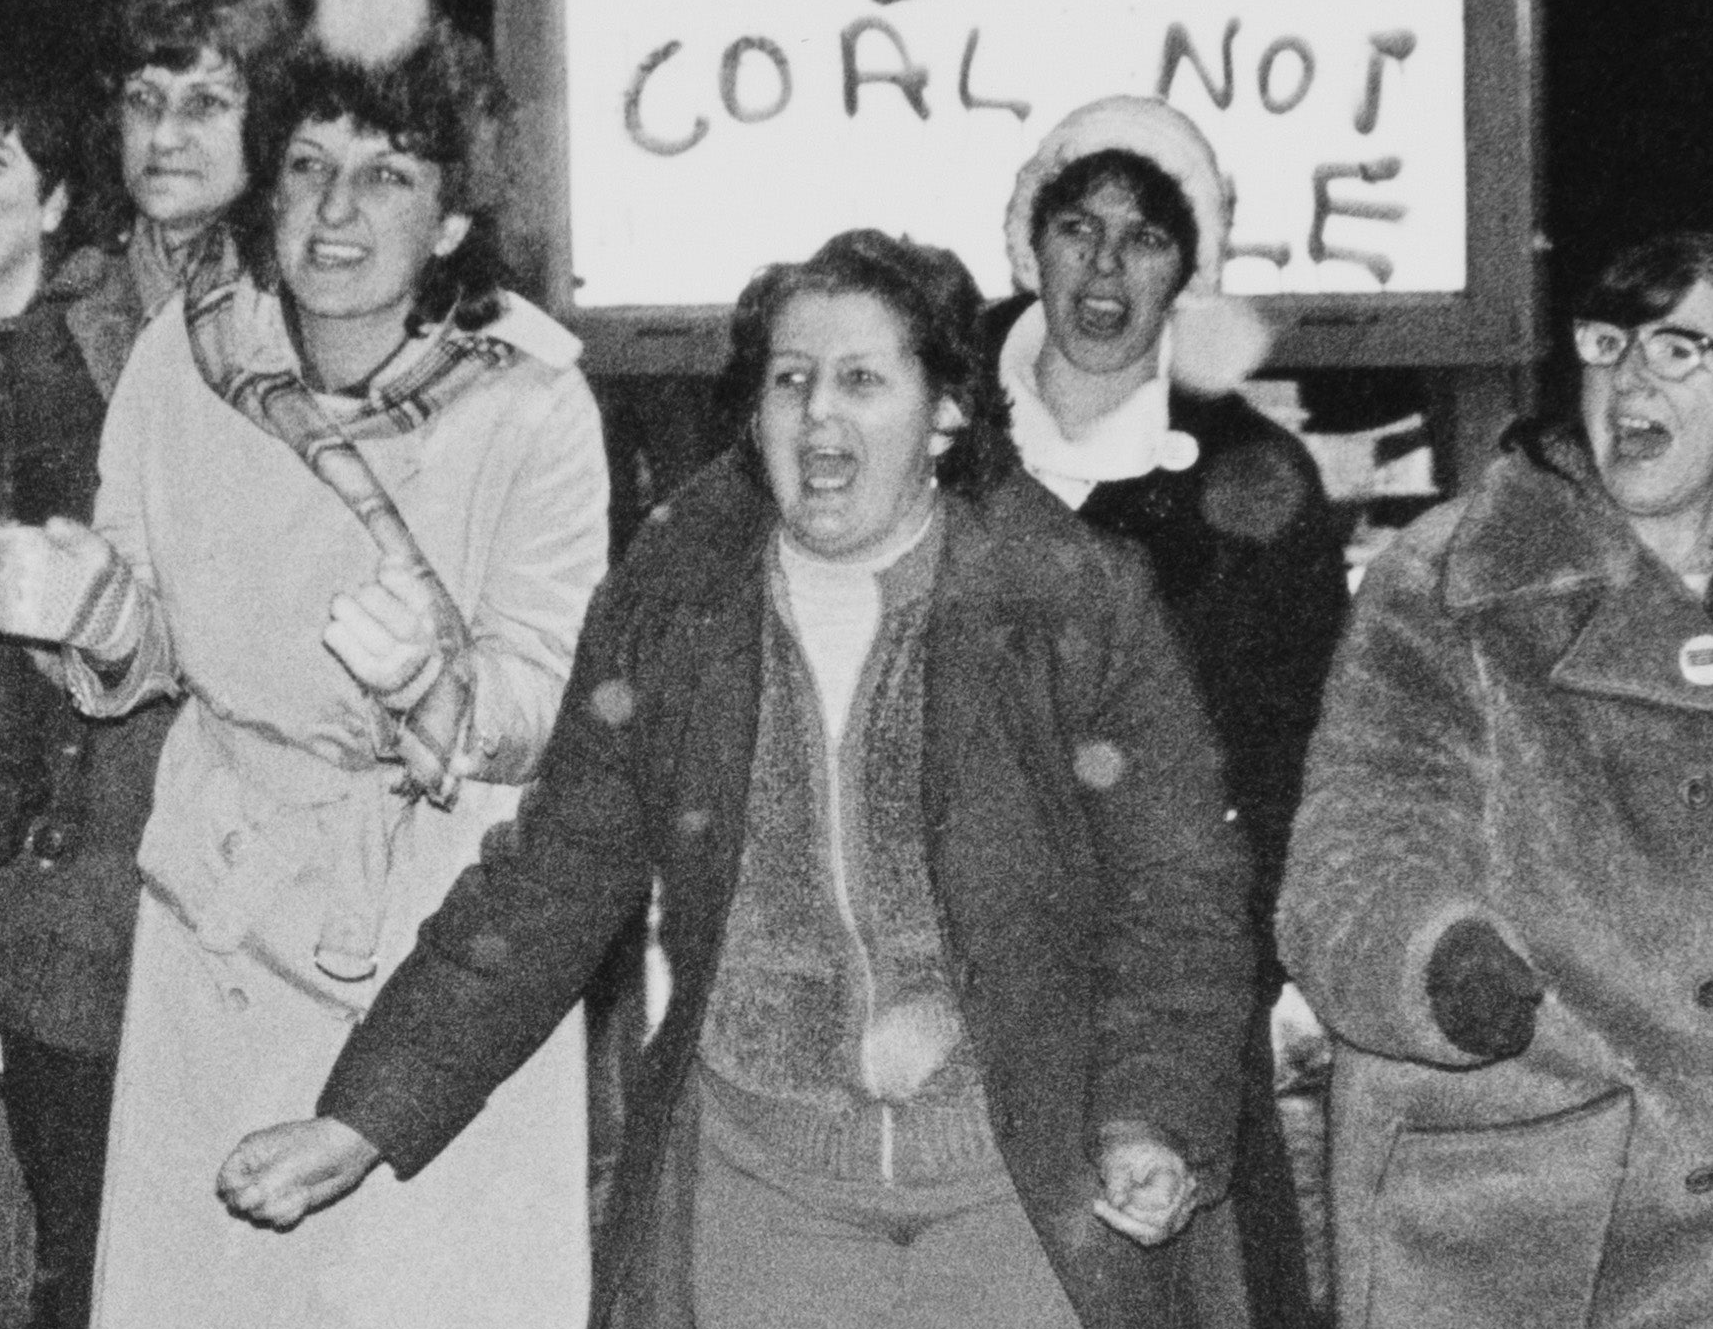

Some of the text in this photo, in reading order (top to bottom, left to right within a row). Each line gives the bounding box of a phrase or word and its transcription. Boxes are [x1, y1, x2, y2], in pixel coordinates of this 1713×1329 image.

[623, 16, 1417, 157] COAL NOT
[1220, 156, 1407, 286] LE
